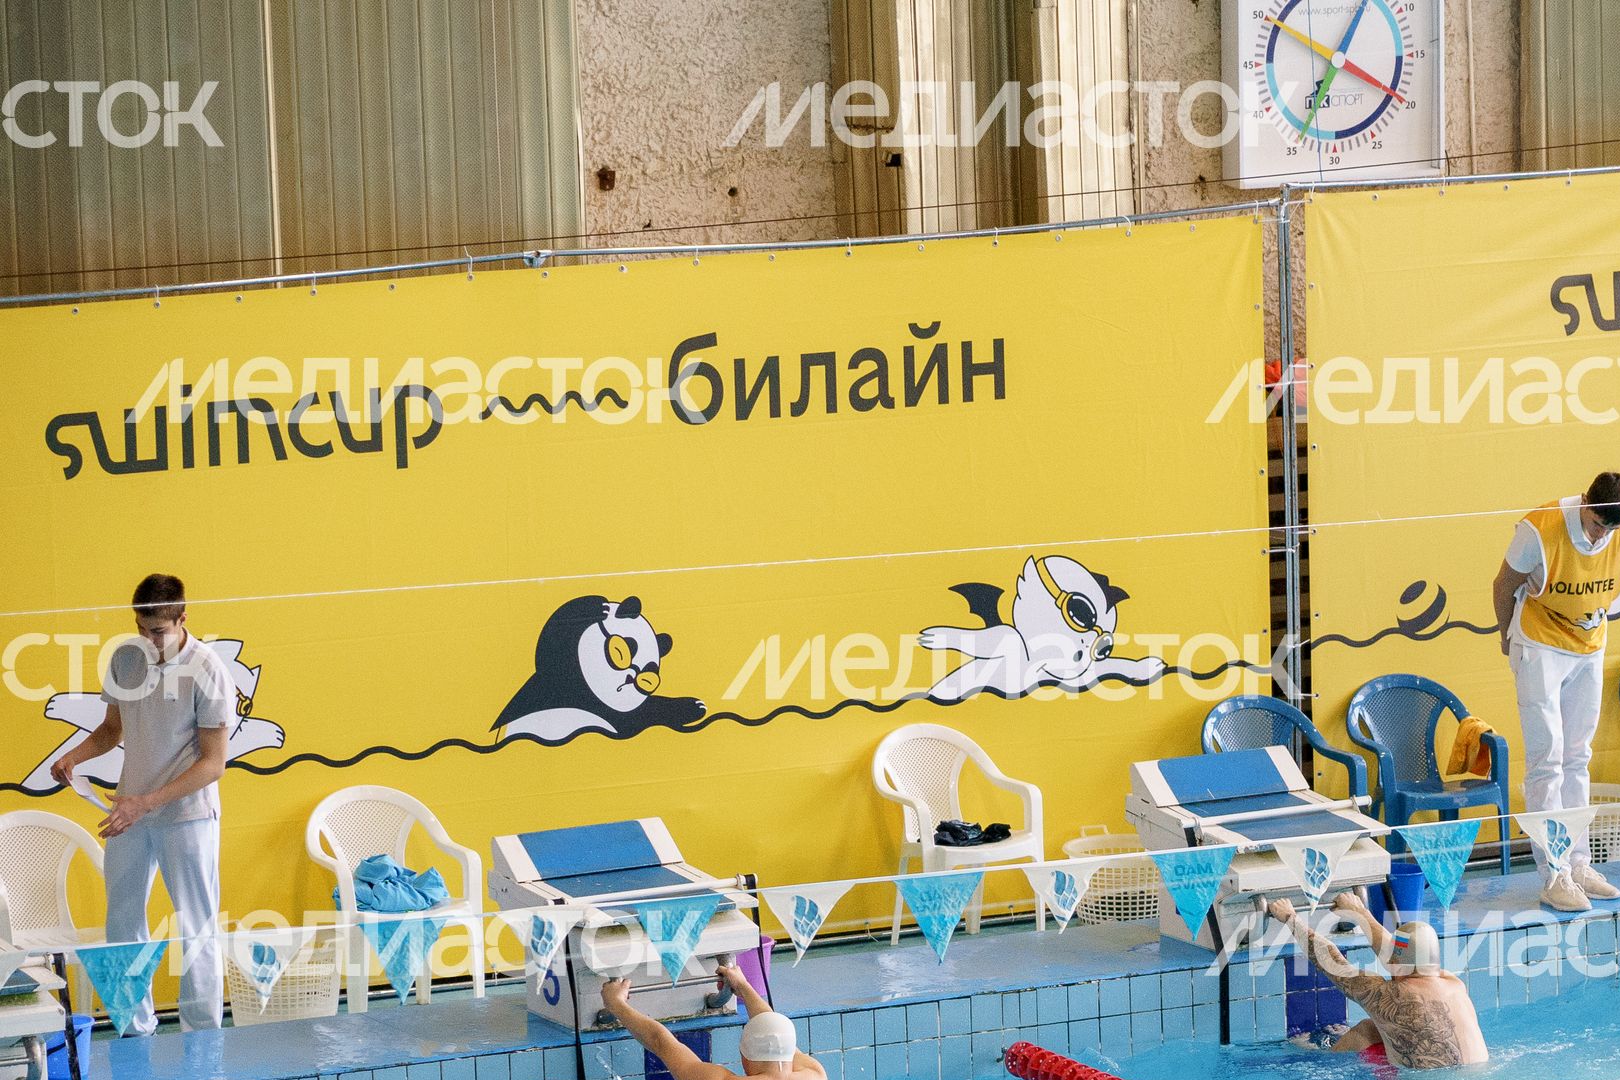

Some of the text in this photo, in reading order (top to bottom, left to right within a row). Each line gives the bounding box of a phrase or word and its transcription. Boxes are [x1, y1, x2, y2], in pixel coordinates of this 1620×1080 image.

[1404, 3, 1415, 12] 10
[1252, 10, 1264, 19] 50
[1415, 49, 1425, 59] 15
[1242, 60, 1254, 70] 45
[1405, 100, 1416, 110] 20
[1252, 110, 1264, 119] 40
[1371, 141, 1383, 150] 25
[1286, 147, 1297, 156] 35
[1329, 156, 1340, 165] 30
[45, 321, 1006, 481] swimcup билайн
[1549, 578, 1615, 595] VOLUNTEE
